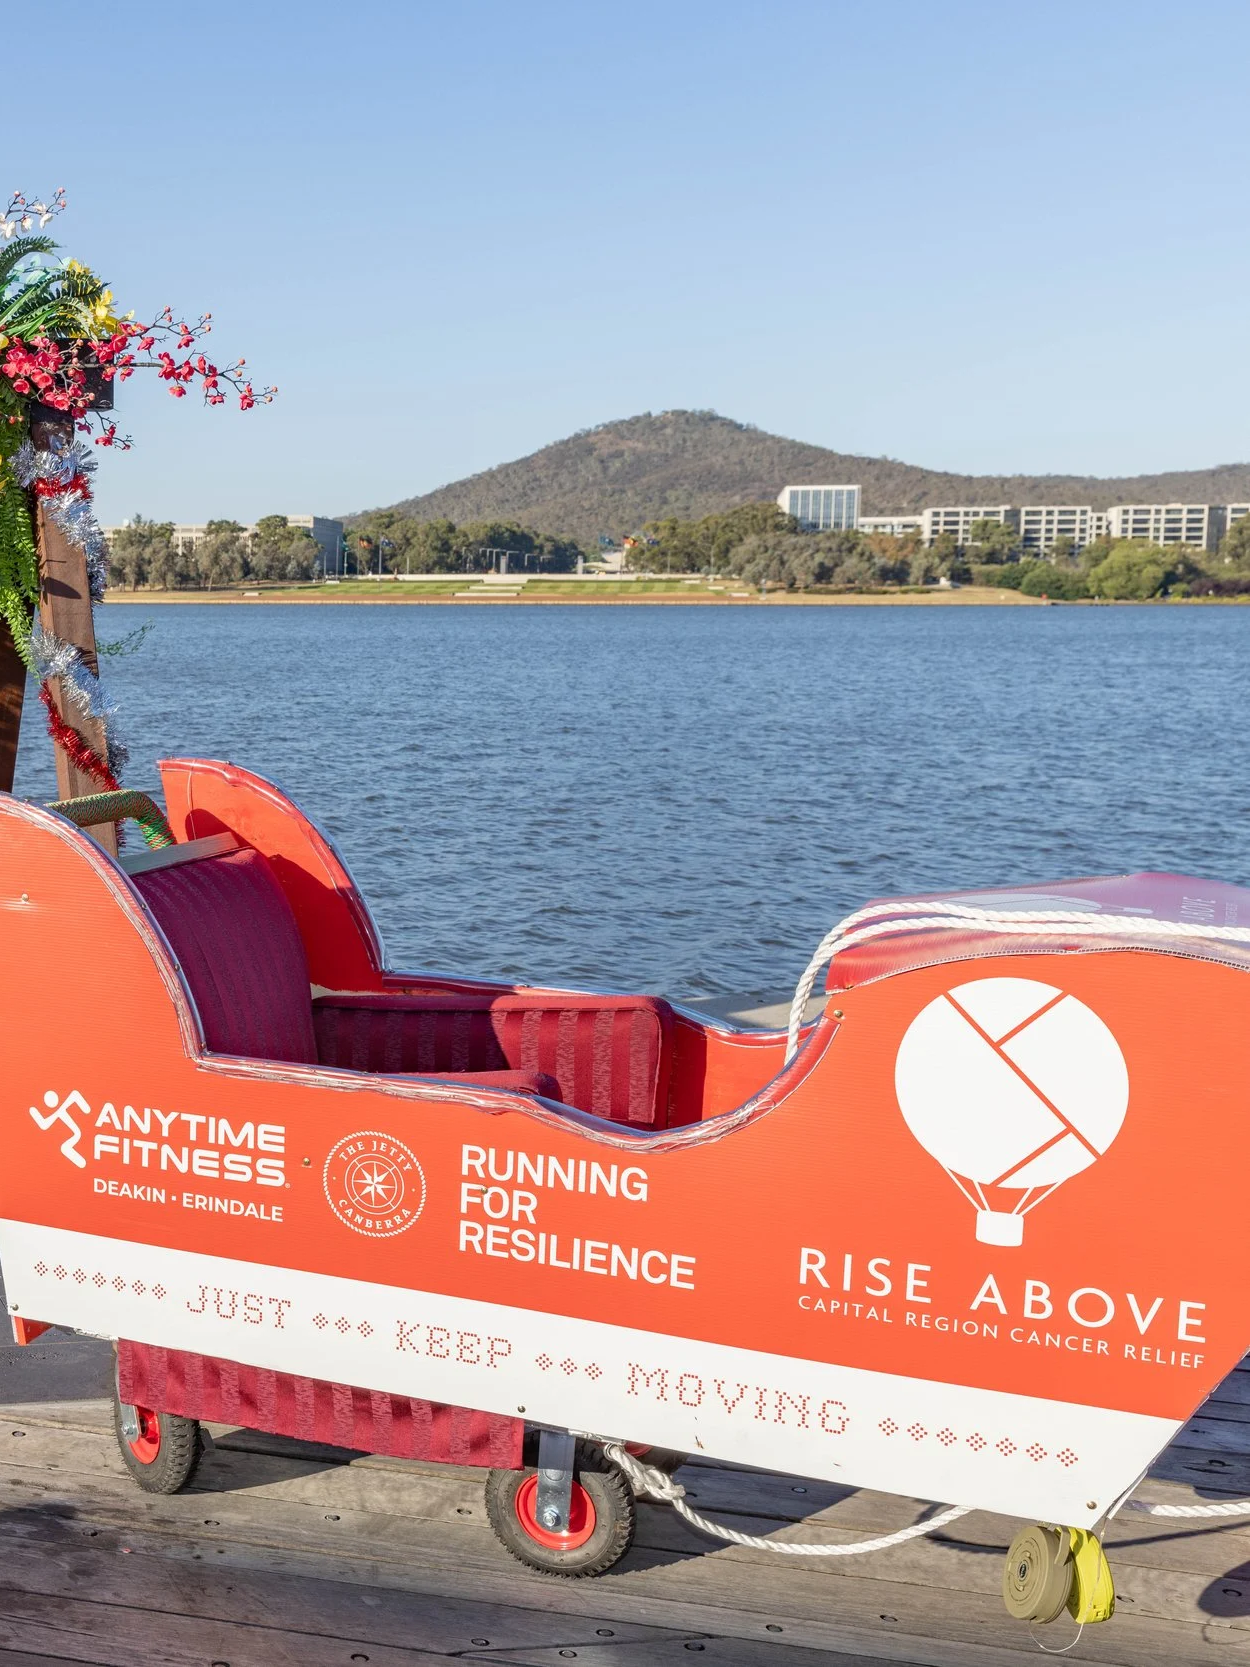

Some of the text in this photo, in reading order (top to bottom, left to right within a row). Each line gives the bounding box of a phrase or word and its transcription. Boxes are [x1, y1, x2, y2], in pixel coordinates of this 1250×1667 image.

[95, 1103, 285, 1153] ANYTIME
[94, 1134, 287, 1187] FITNESS
[339, 1140, 413, 1171] THE JETTY
[462, 1145, 648, 1201] RUNNING
[94, 1178, 282, 1222] DEAKIN ERINDALE
[339, 1199, 411, 1230] CANBERRA
[461, 1183, 537, 1224] FOR
[460, 1220, 695, 1289] RESILIENCE
[800, 1248, 1205, 1343] RISE ABOVE
[799, 1296, 1203, 1368] CAPITAL REGION CANCER RELIEF
[186, 1285, 850, 1434] JUST KEEP MOVING
